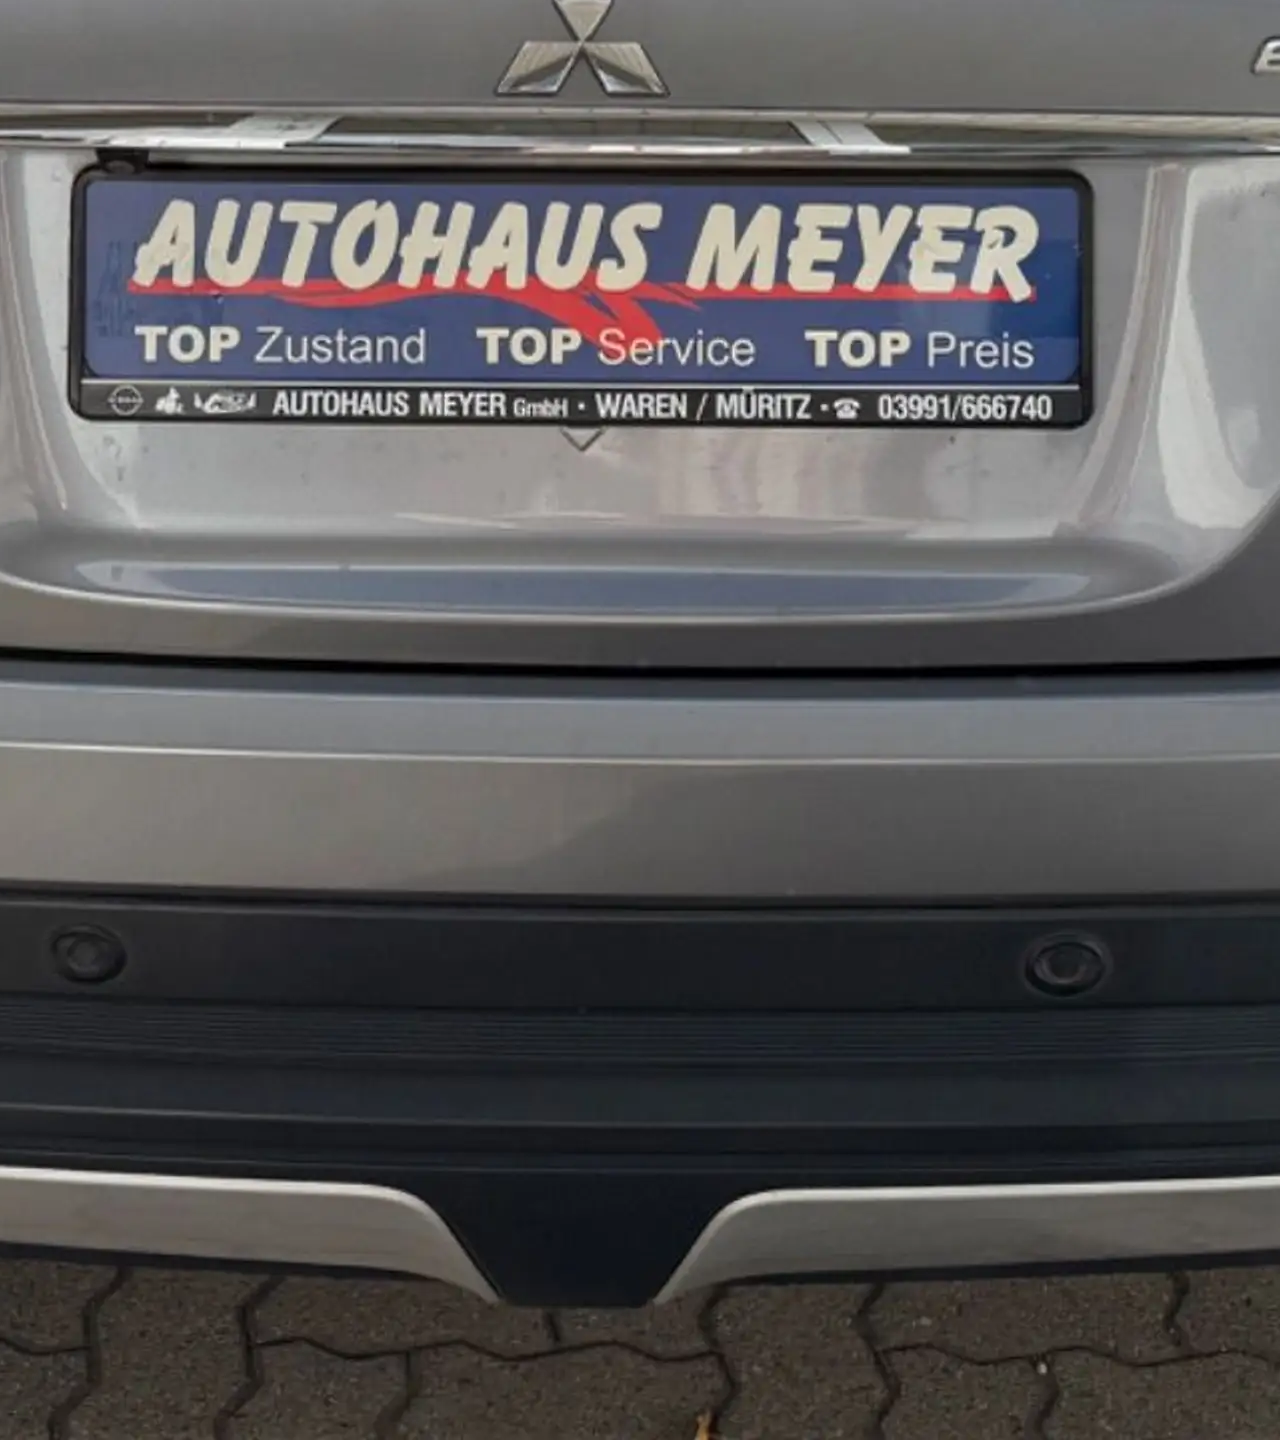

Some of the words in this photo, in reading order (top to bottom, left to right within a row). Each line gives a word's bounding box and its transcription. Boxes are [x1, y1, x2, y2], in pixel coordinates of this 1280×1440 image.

[132, 198, 663, 291] AUTOHAUS
[685, 203, 1040, 303] MEYER
[135, 325, 241, 362] TOP
[254, 327, 426, 364] Zustand
[476, 327, 582, 364] TOP
[597, 329, 757, 367] Service
[804, 330, 912, 368] TOP
[927, 331, 1034, 368] Preis
[272, 390, 410, 417] AUTOHAUS
[419, 392, 507, 418] MEYER
[513, 398, 569, 418] GmbH
[595, 393, 687, 419] WAREN
[716, 387, 812, 420] MÜRITZ
[878, 394, 1052, 422] 03991/666740
